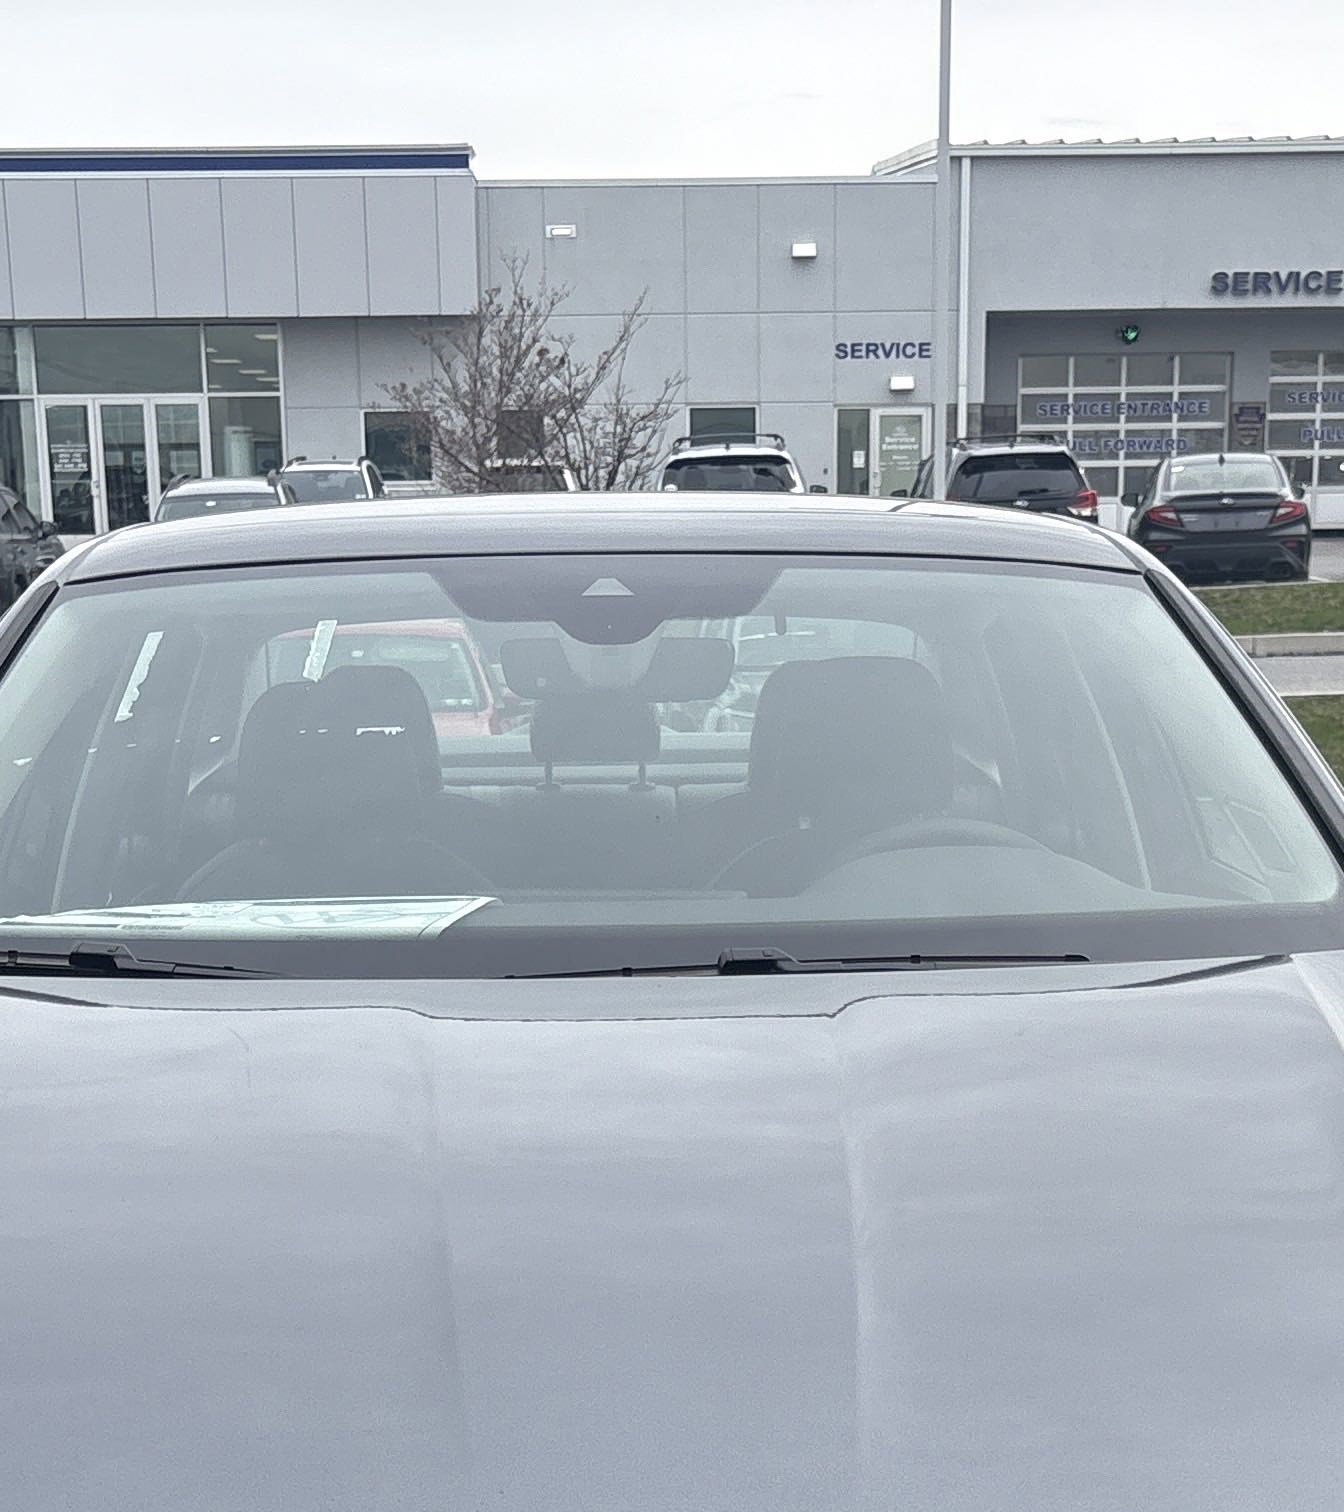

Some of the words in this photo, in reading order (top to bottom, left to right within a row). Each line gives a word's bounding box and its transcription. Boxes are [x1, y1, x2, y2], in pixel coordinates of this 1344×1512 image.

[1210, 270, 1344, 297] SERVICE
[834, 342, 932, 360] SERVICE
[1038, 403, 1111, 417] SERVICE
[1117, 401, 1209, 415] ENTRANCE
[1302, 428, 1344, 442] PULL
[1103, 438, 1188, 452] FORWARD
